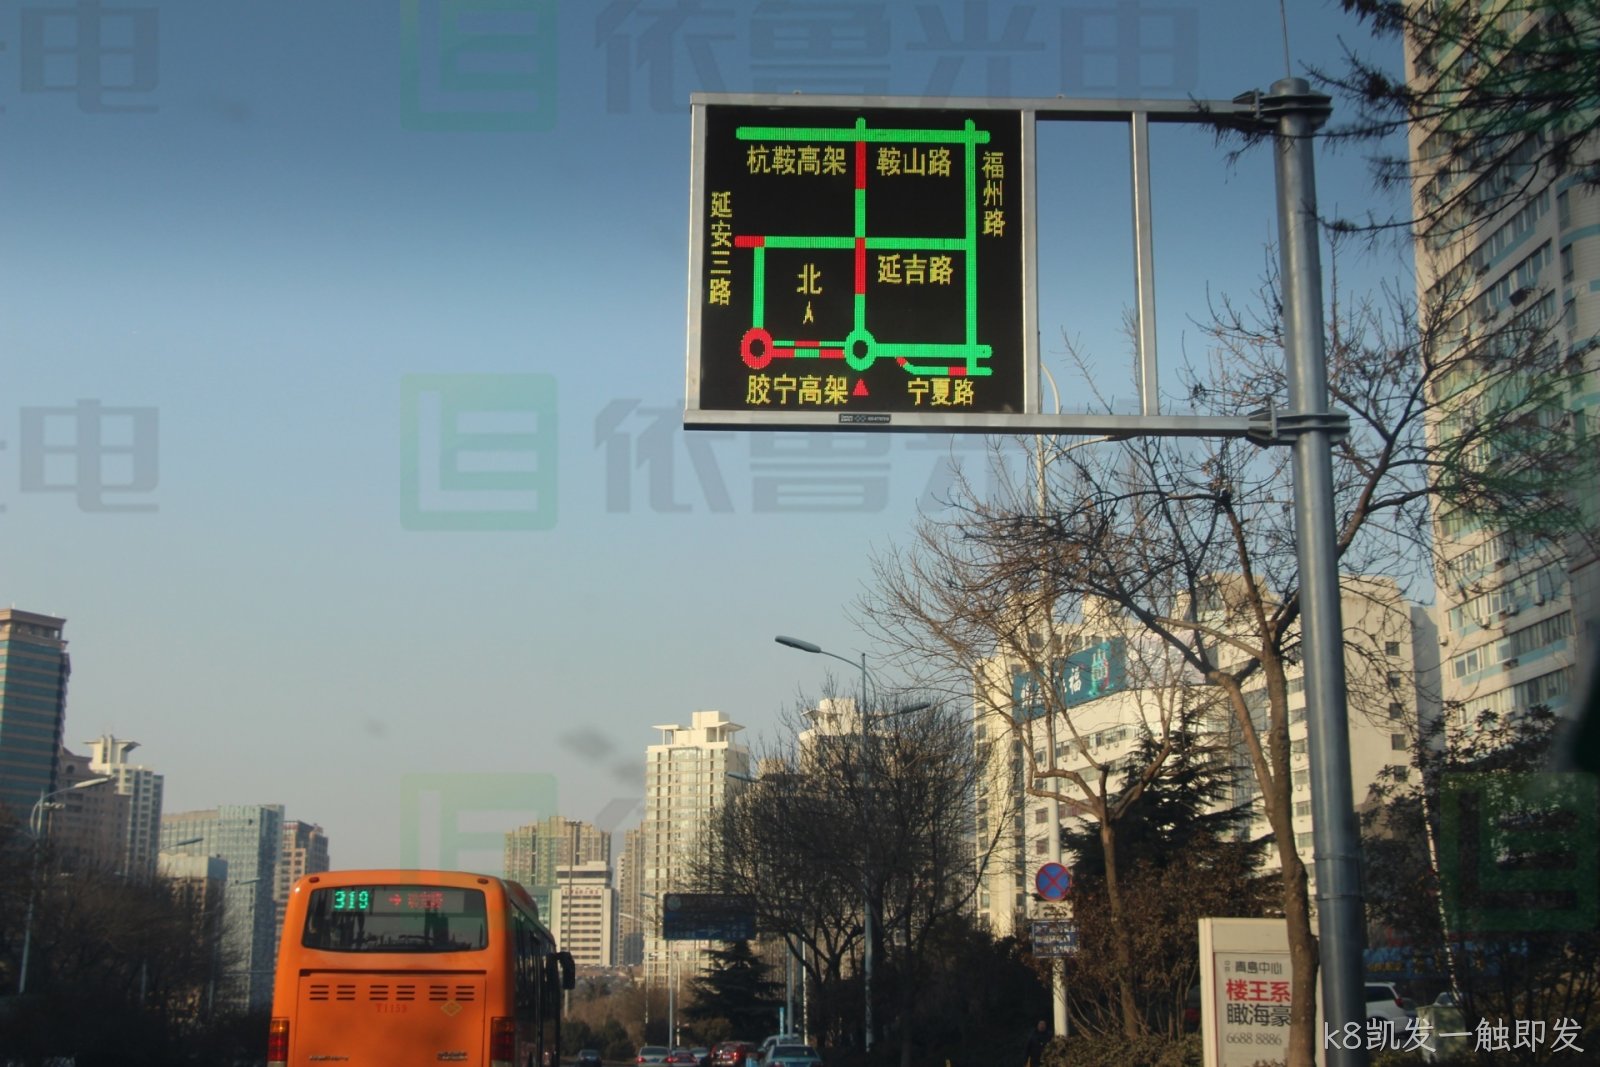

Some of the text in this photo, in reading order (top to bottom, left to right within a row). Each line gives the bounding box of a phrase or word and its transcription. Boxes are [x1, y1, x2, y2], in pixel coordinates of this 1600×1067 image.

[747, 145, 846, 176] 杭鞍高架
[876, 147, 952, 177] 鞍山路
[982, 151, 1006, 237] 福州路
[709, 191, 732, 306] 延安三路
[796, 263, 822, 295] 北
[877, 254, 954, 285] 延吉路
[745, 374, 849, 405] 胶宁高架
[907, 378, 974, 406] 宁夏路
[334, 889, 369, 909] 319
[1226, 979, 1290, 1002] 楼王系
[1226, 1003, 1292, 1027] 瞰海豪
